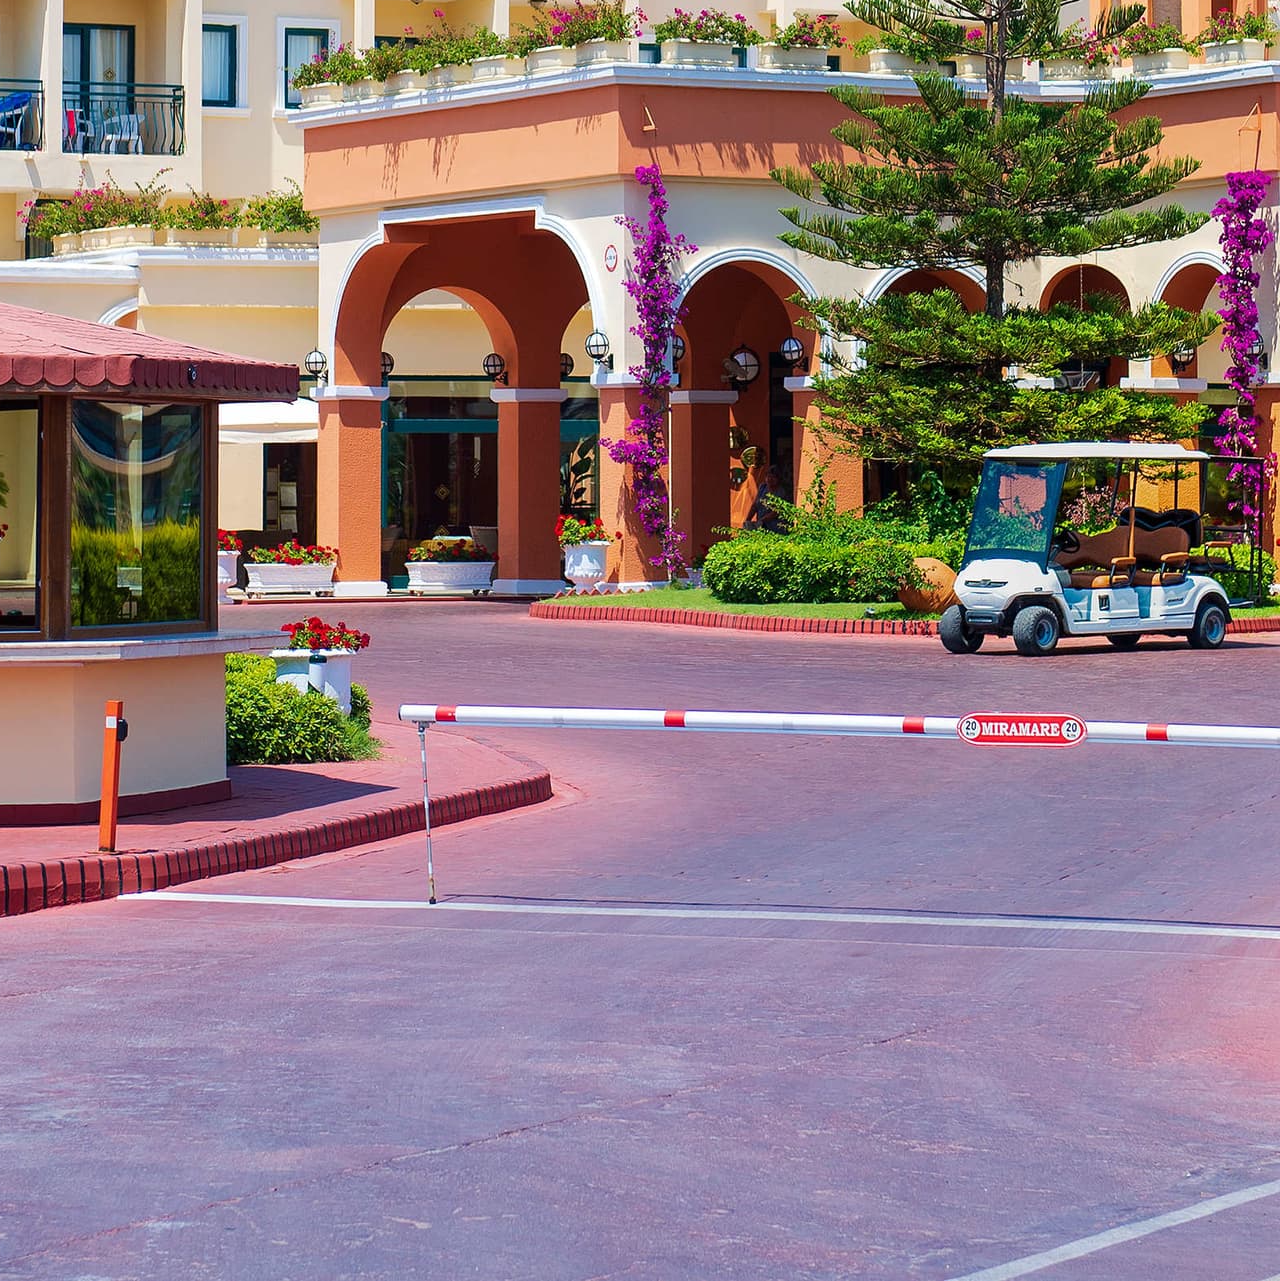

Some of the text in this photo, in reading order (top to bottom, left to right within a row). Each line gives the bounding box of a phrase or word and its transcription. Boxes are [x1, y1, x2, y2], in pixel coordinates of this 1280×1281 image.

[965, 720, 977, 731] 20
[981, 722, 1060, 737] MIRAMARE
[1066, 722, 1078, 733] 20
